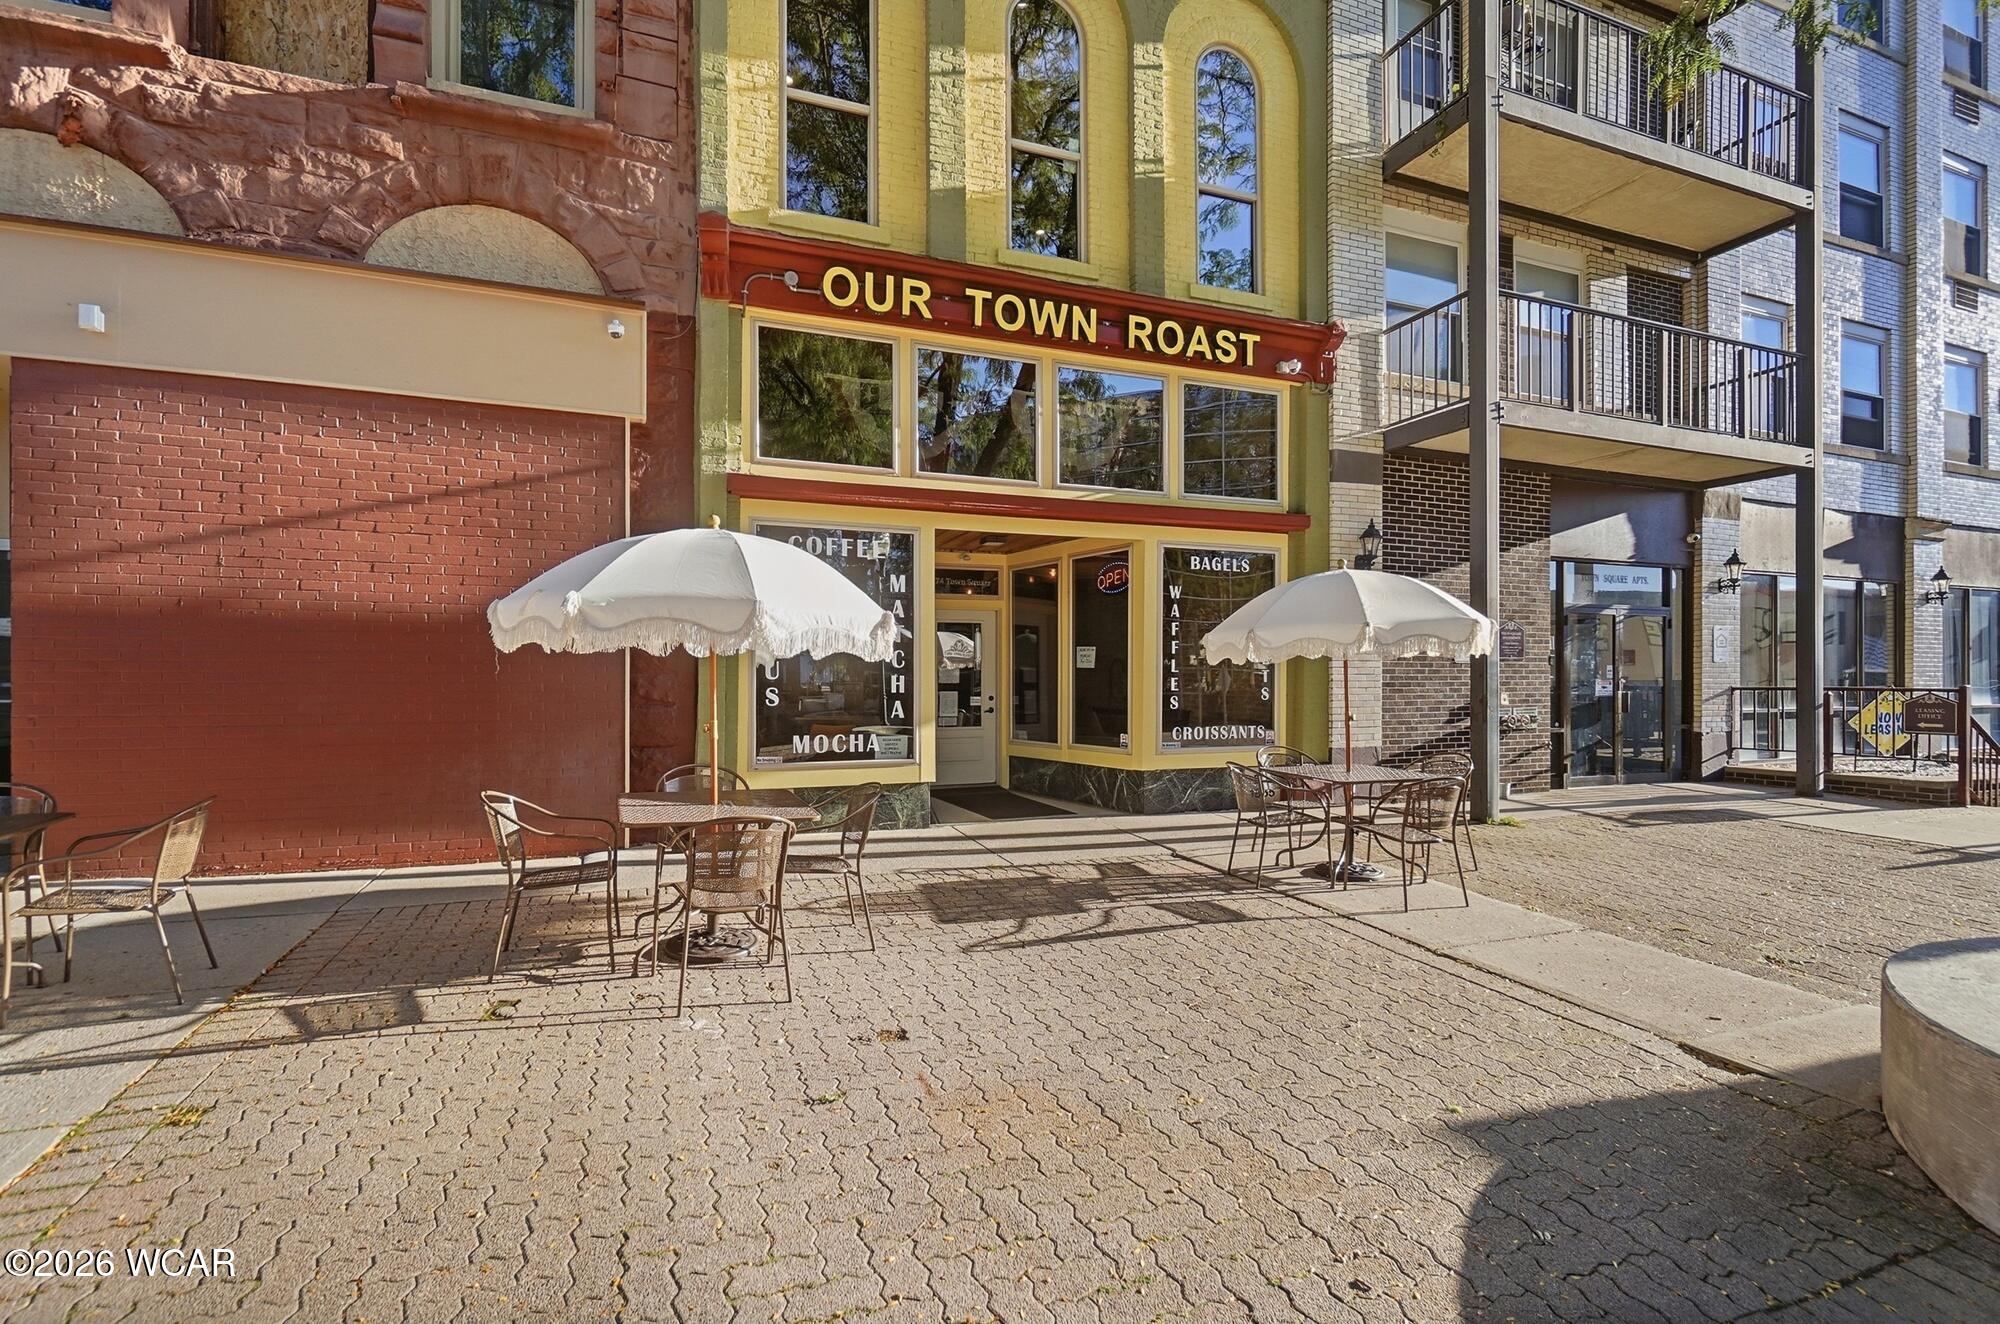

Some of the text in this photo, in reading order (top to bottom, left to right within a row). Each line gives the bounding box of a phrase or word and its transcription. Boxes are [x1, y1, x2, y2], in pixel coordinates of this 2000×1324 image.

[823, 266, 1261, 366] OUR TOWN ROAST
[1190, 556, 1250, 573] BAGELS
[1097, 568, 1129, 589] OPEN
[1603, 574, 1628, 584] SQUARE
[1169, 585, 1182, 710] WAFFLES
[1172, 725, 1265, 741] CROISSANTS
[792, 733, 881, 755] MOCHA
